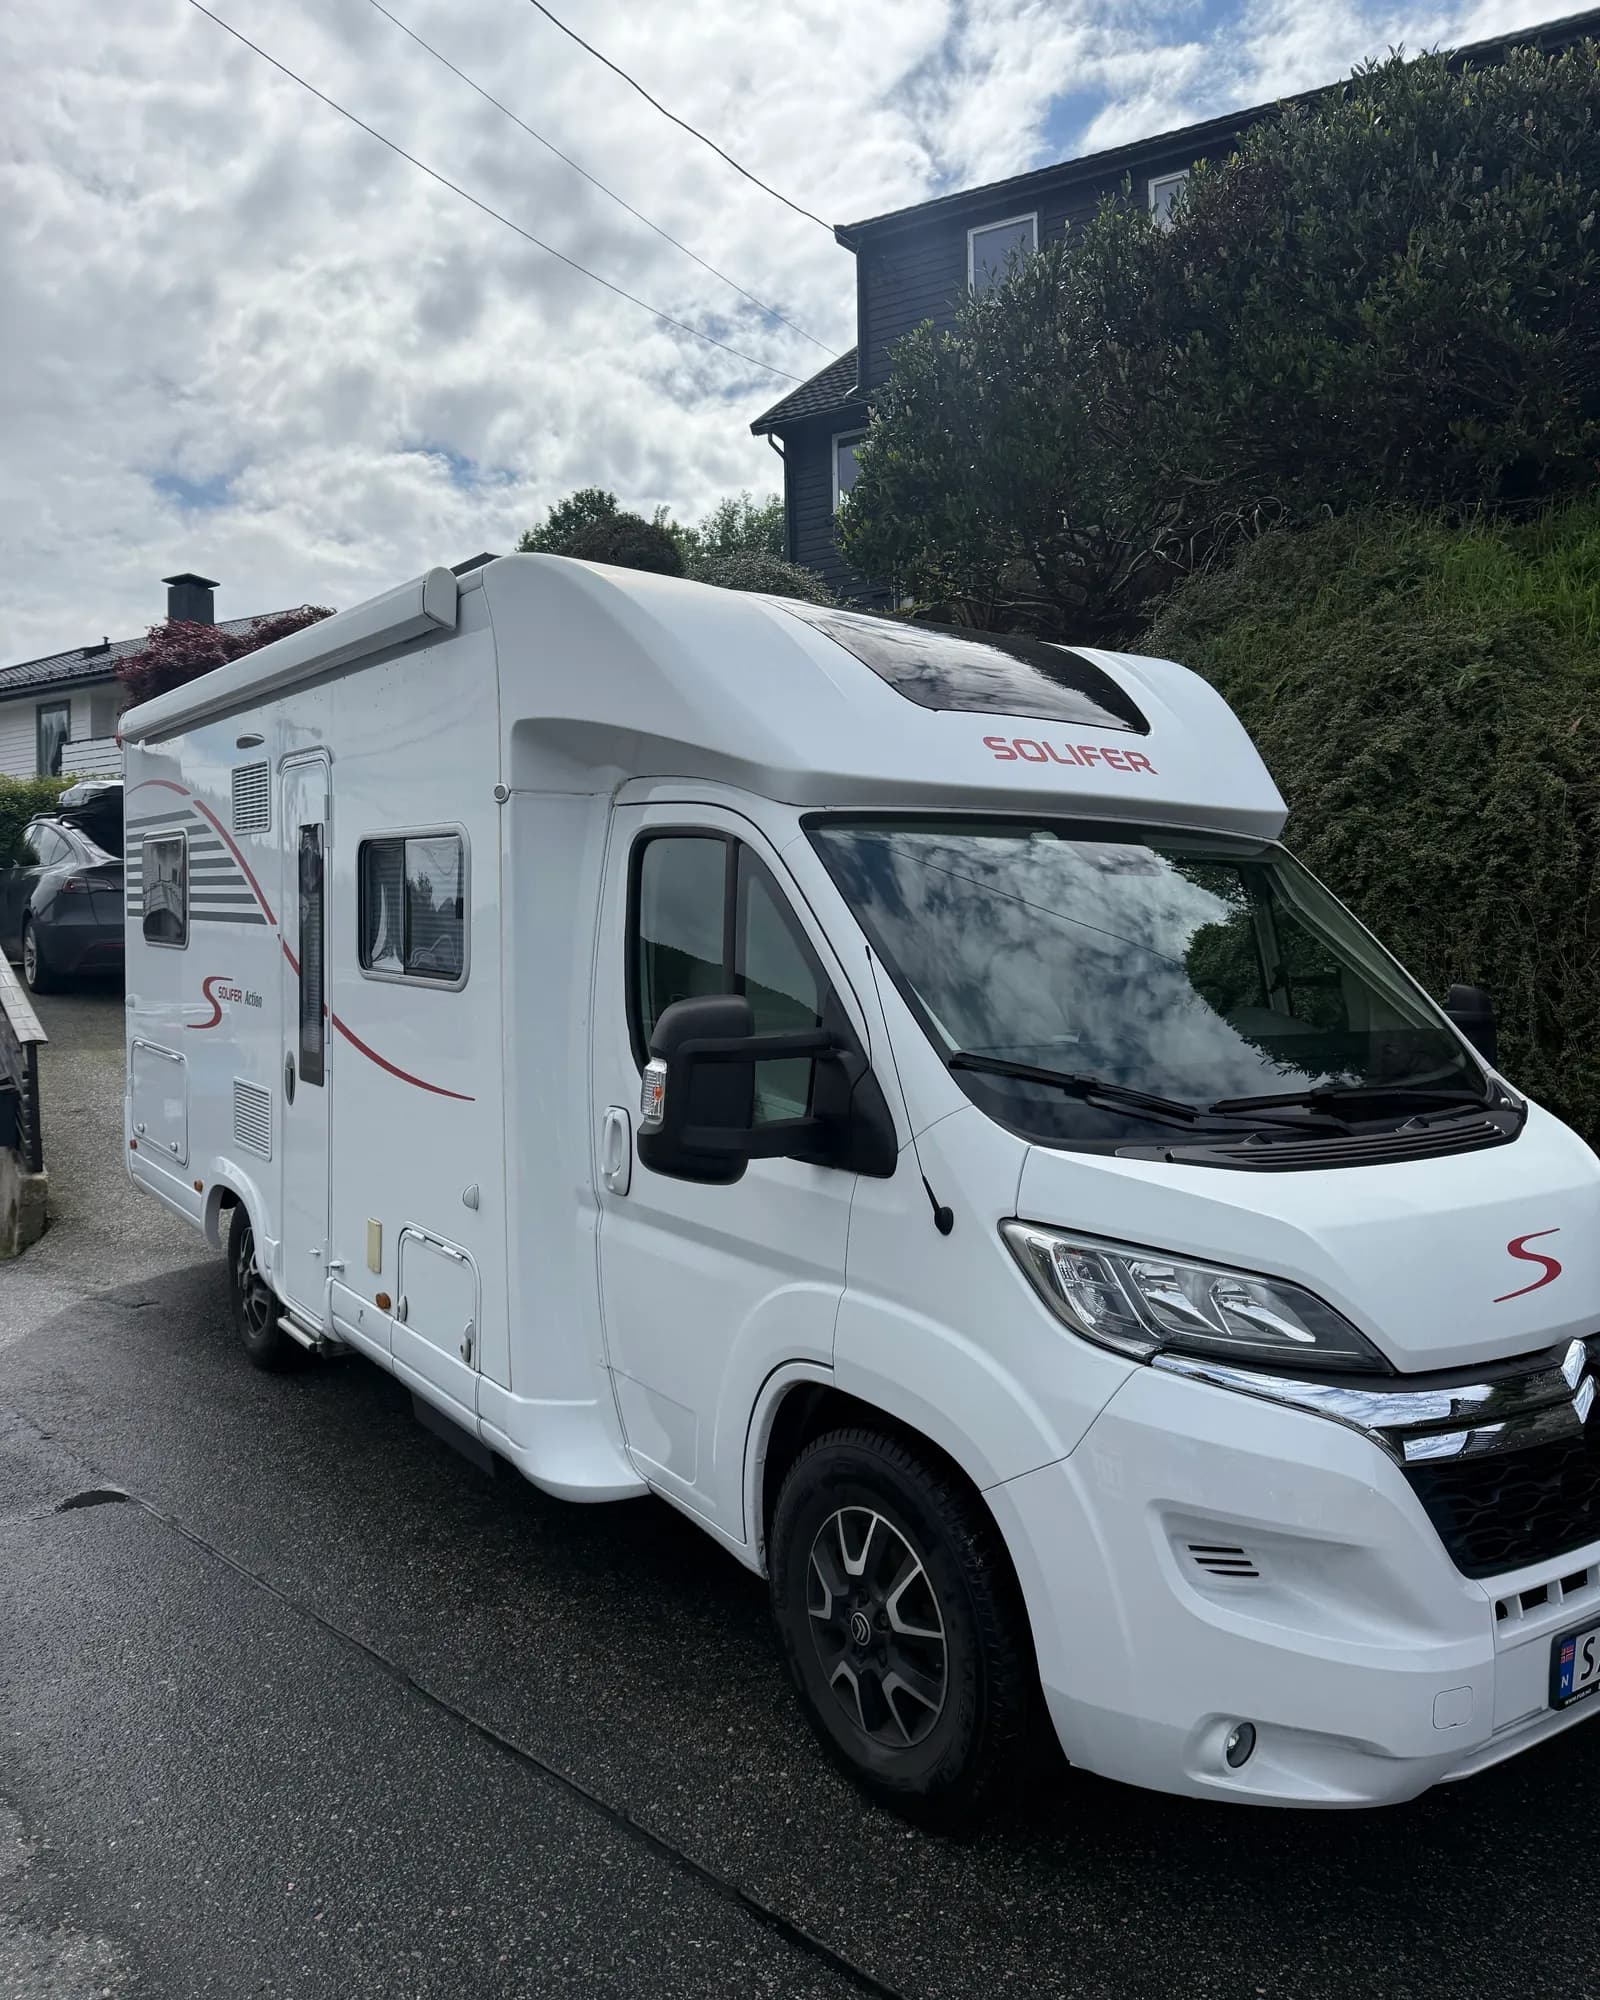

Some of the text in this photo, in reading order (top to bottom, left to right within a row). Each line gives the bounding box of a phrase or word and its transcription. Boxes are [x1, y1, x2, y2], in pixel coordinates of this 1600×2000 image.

[982, 736, 1160, 776] SOLIFER
[186, 976, 233, 1029] S
[218, 986, 263, 1009] SOLIFER Action
[1492, 1228, 1562, 1303] S
[1580, 1636, 1600, 1681] S
[1561, 1674, 1570, 1689] N
